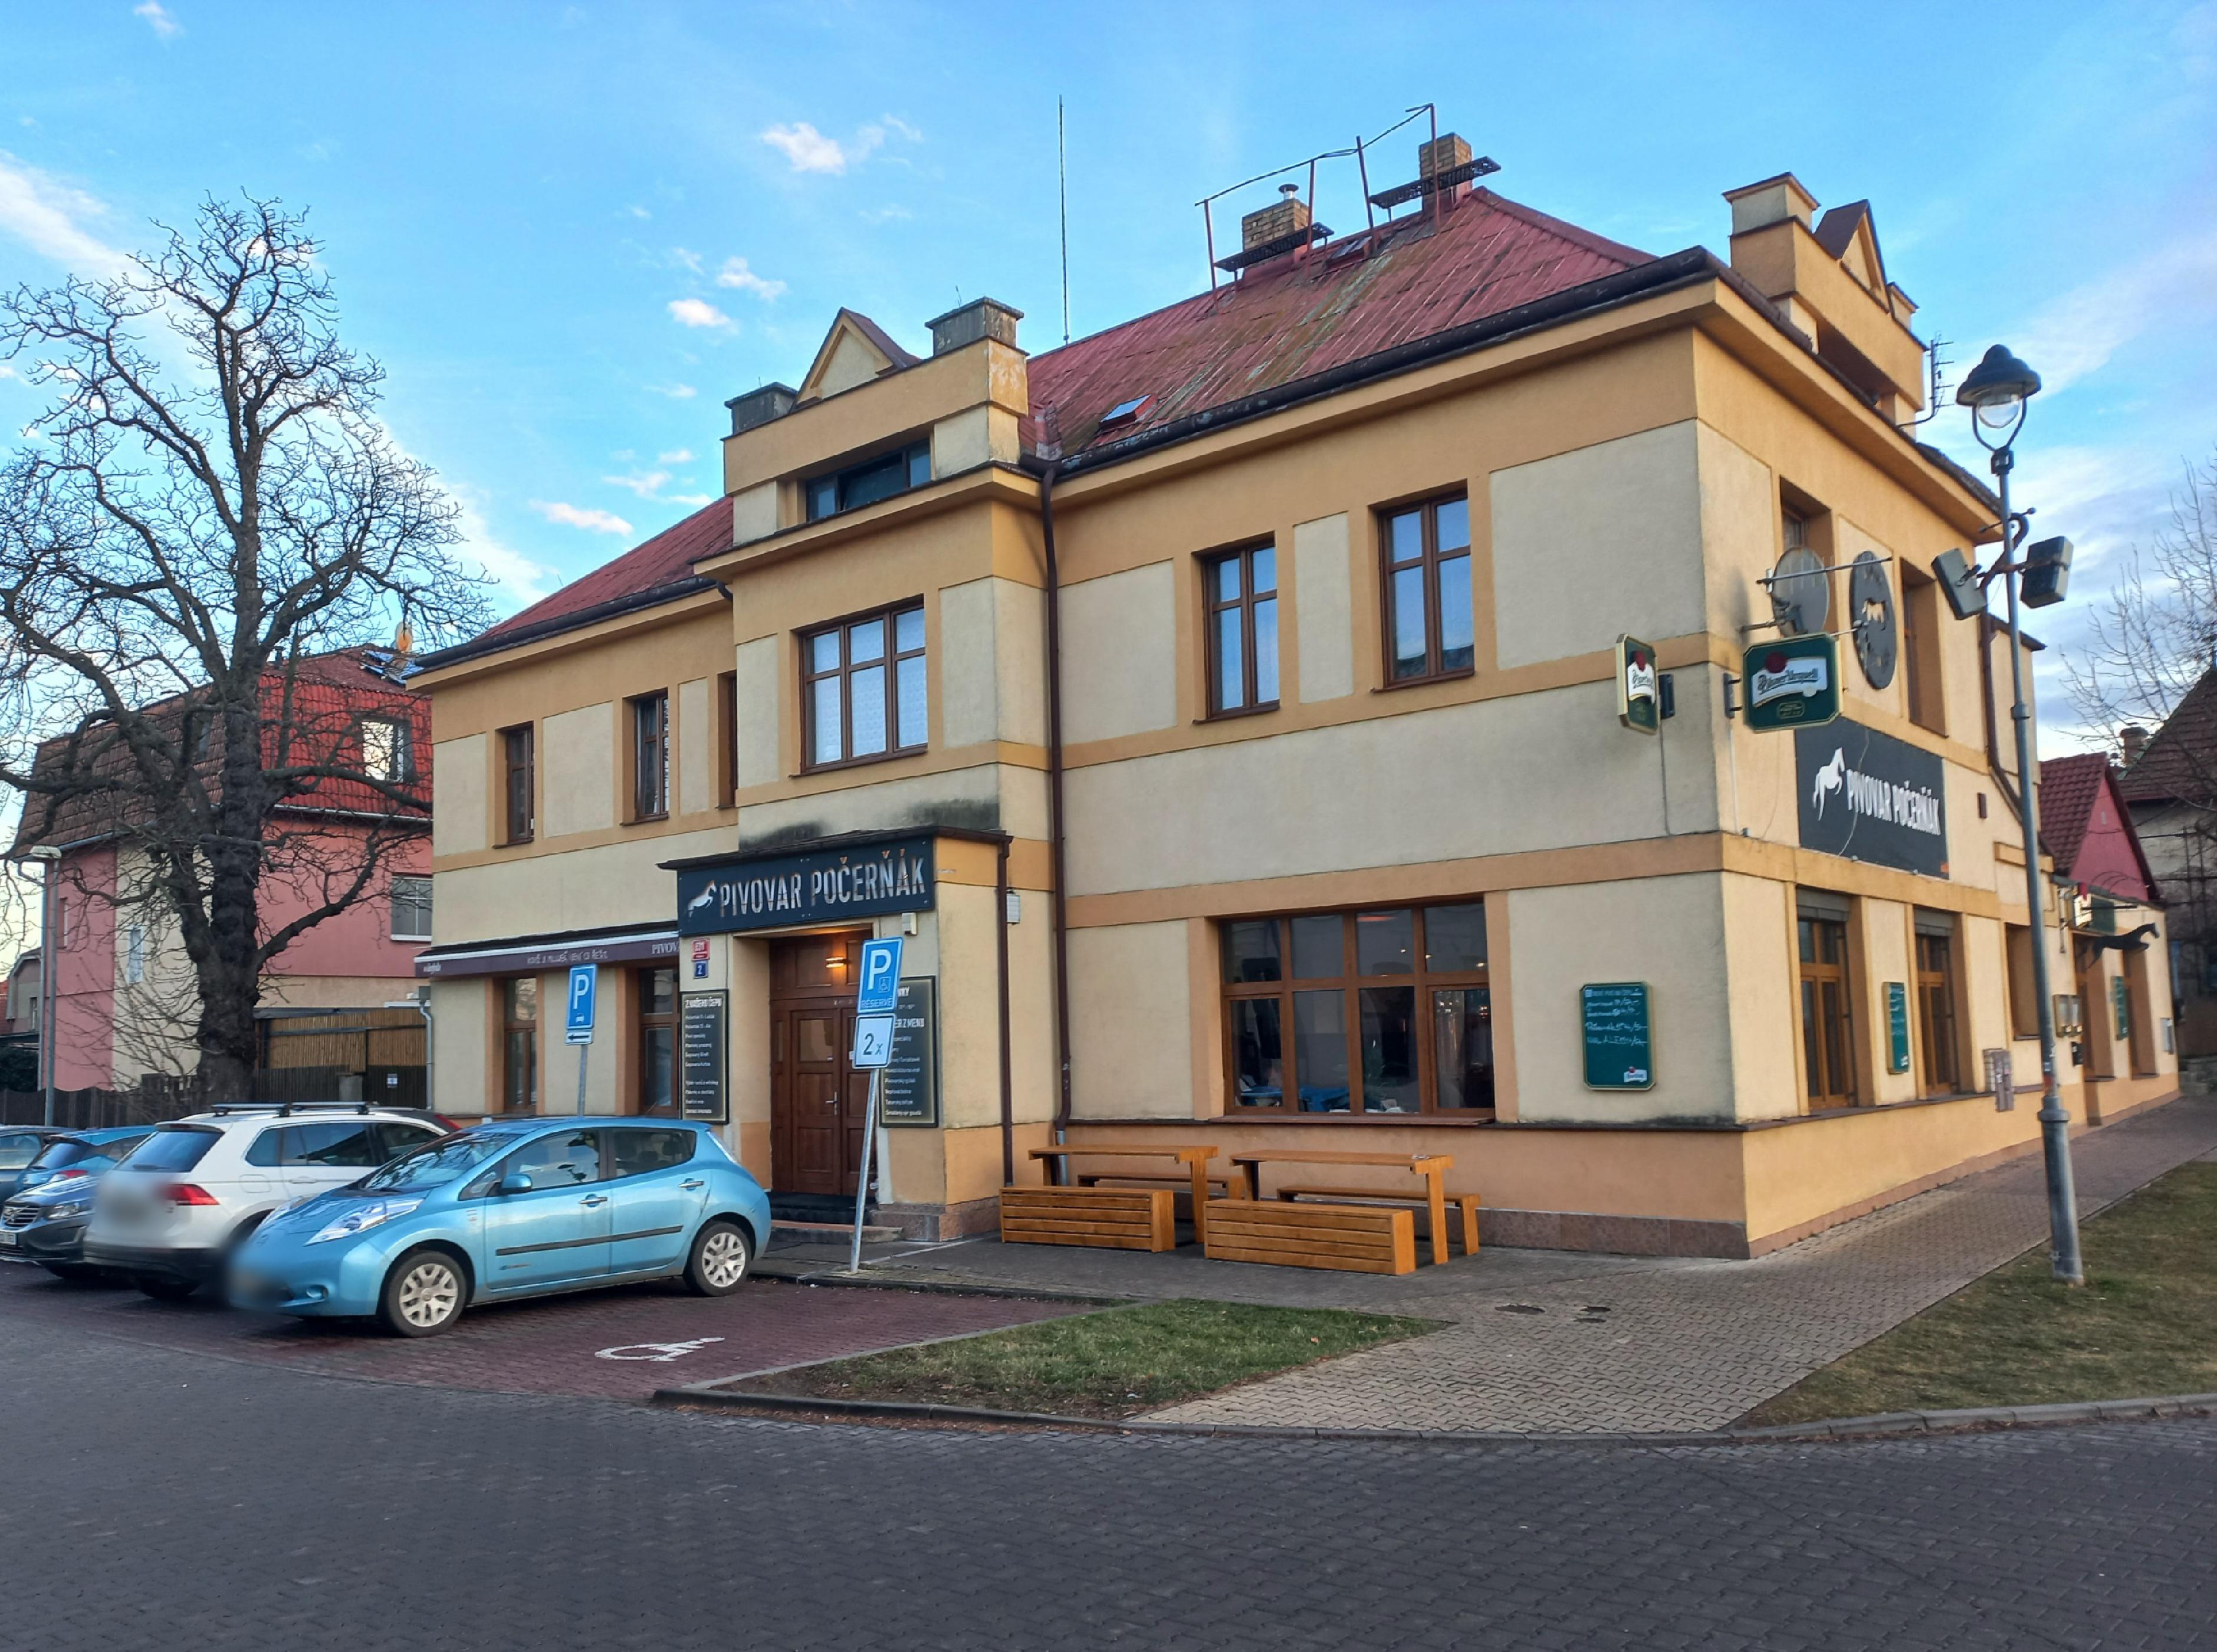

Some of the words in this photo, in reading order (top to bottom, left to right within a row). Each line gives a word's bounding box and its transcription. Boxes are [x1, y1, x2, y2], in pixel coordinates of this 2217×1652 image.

[1846, 768, 1892, 821] PIVOVAR
[720, 872, 802, 917] PIVOVAR
[810, 848, 926, 907] POČERŇÁK
[651, 942, 679, 954] PIVOV
[868, 949, 892, 990] P
[573, 974, 590, 1009] P
